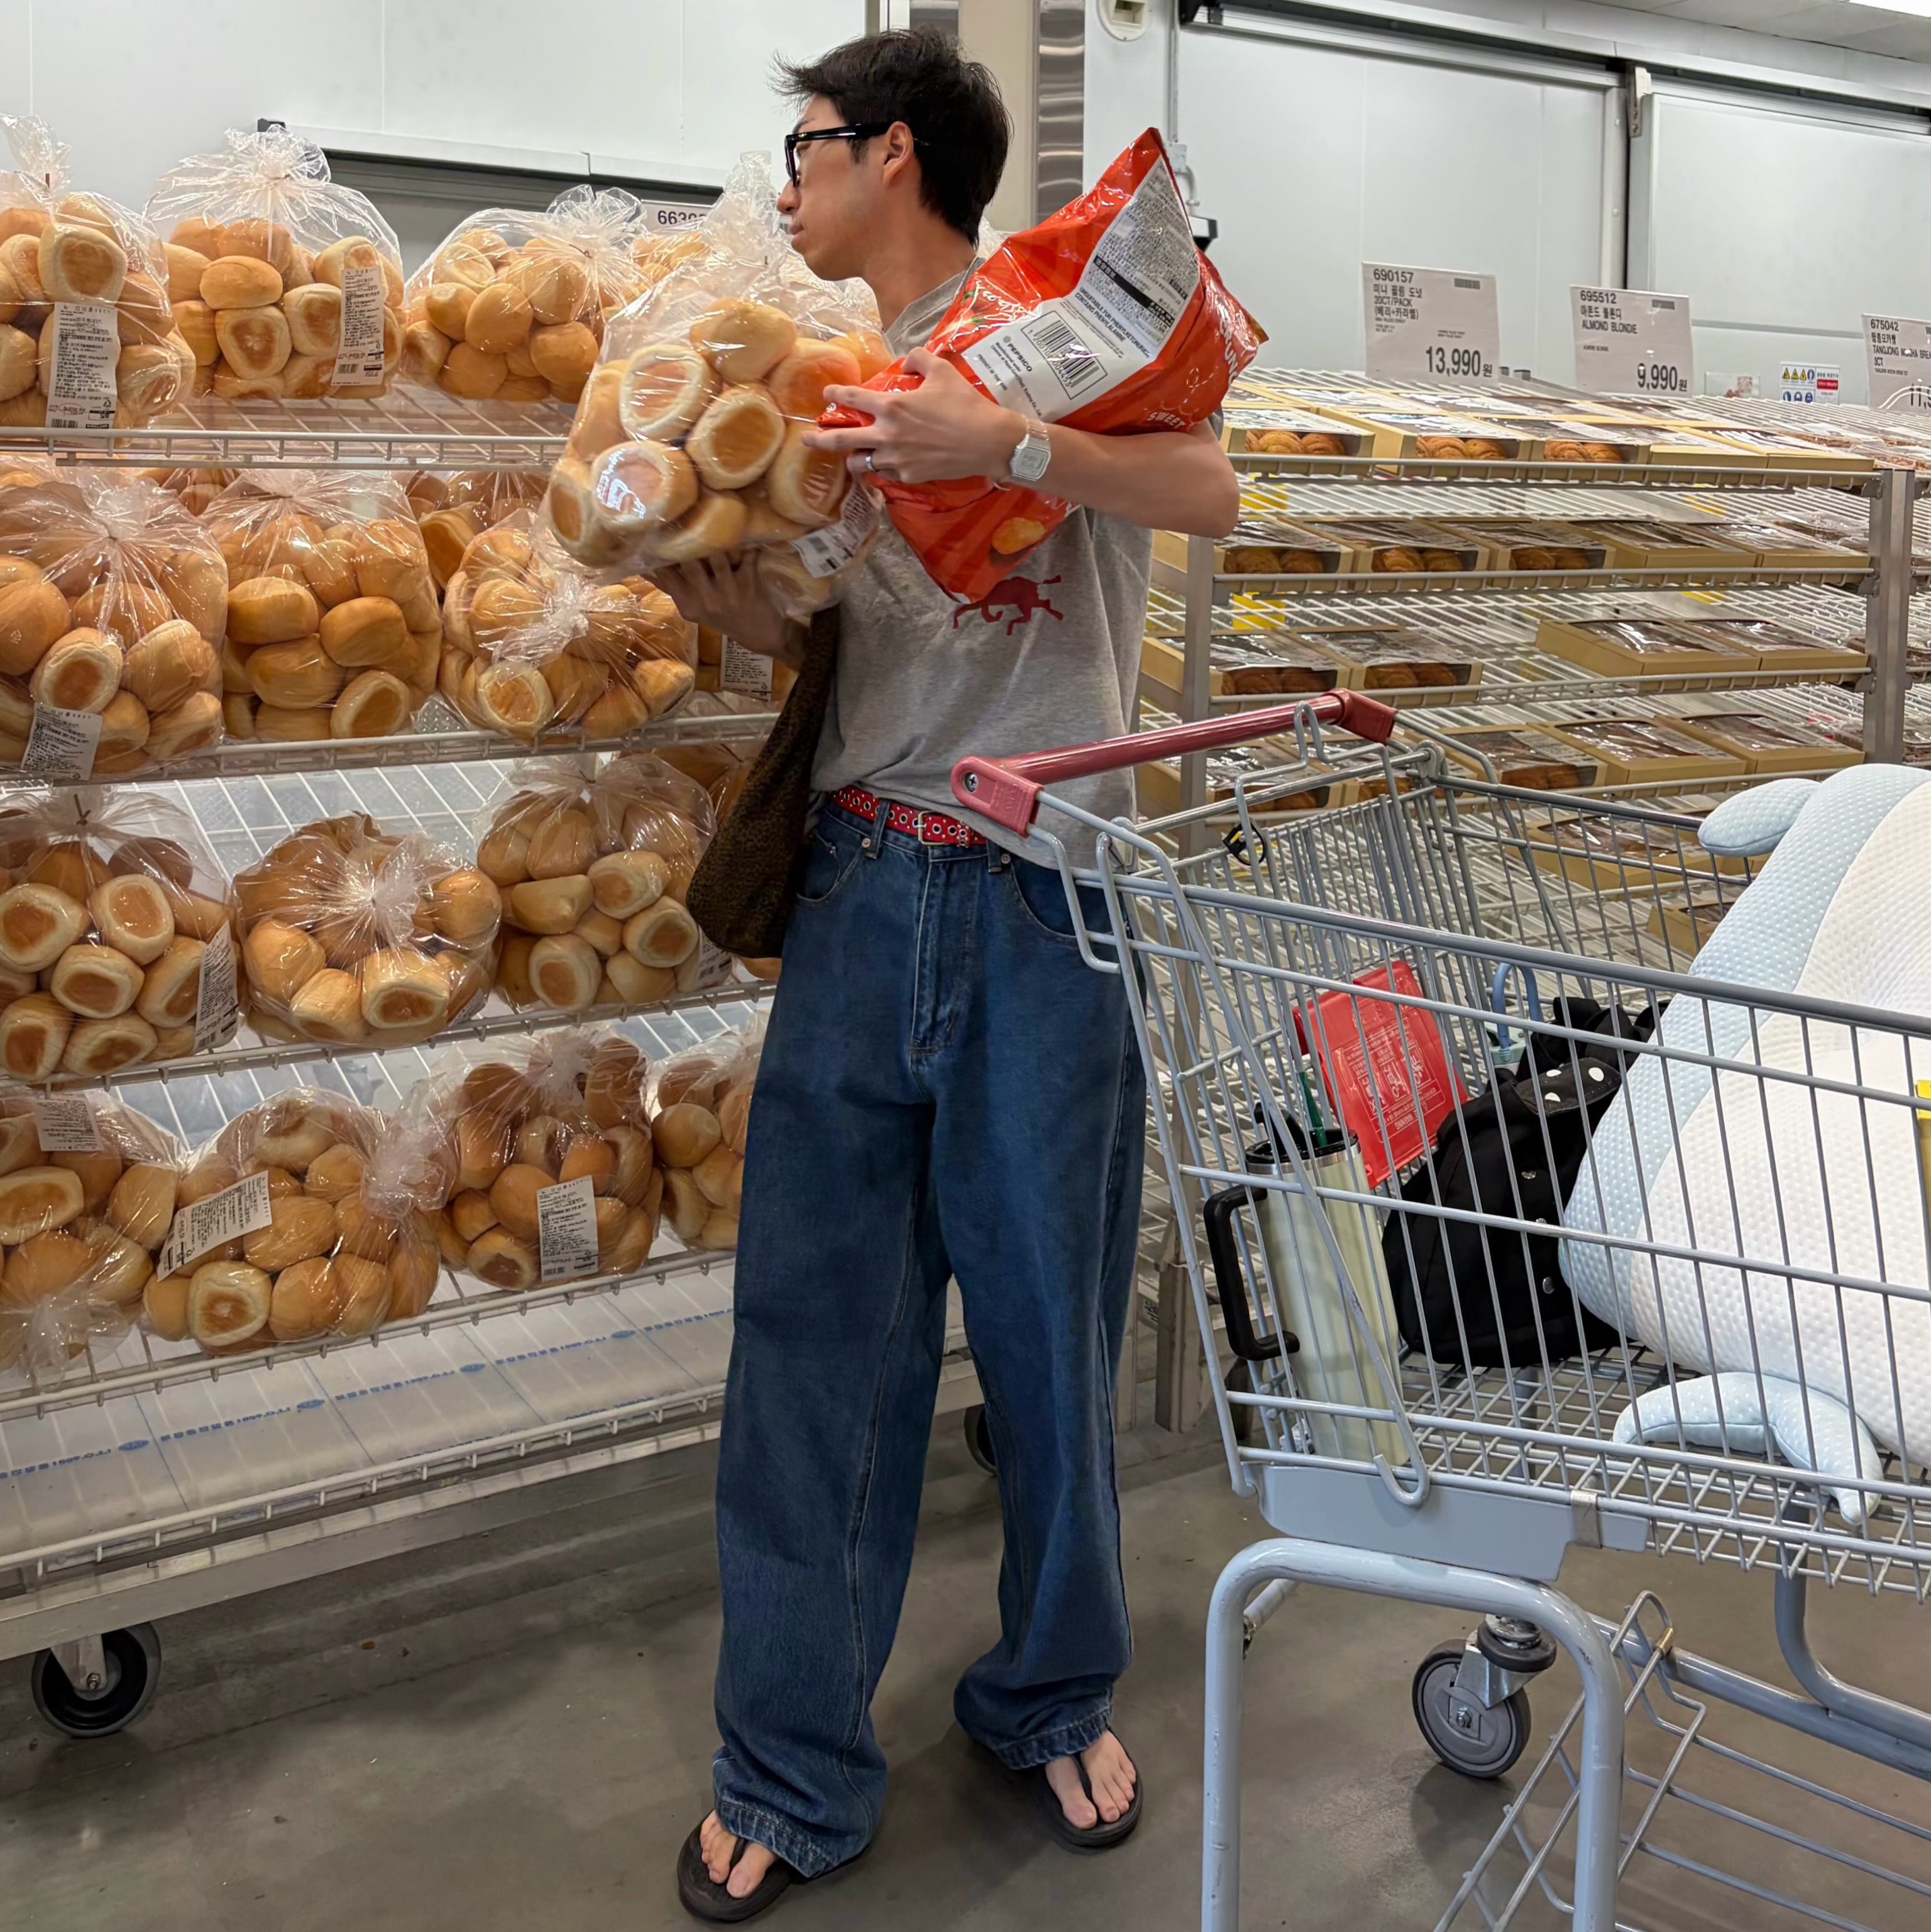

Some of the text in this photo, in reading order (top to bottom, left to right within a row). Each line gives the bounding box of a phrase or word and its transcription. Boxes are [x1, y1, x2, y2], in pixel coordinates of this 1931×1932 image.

[1373, 268, 1414, 283] 690157
[1373, 284, 1387, 295] 미니
[1409, 287, 1422, 299] 도넛
[1580, 290, 1617, 304] 695512
[1373, 295, 1412, 308] 20CT/PACK
[1582, 319, 1637, 334] ALMOND BLONDIE
[1871, 319, 1899, 331] 675042
[1008, 343, 1032, 372] PEPSICO
[1873, 345, 1899, 356] TANGJONG
[1147, 411, 1186, 429] SWEET
[1395, 1113, 1413, 1130] WARNING
